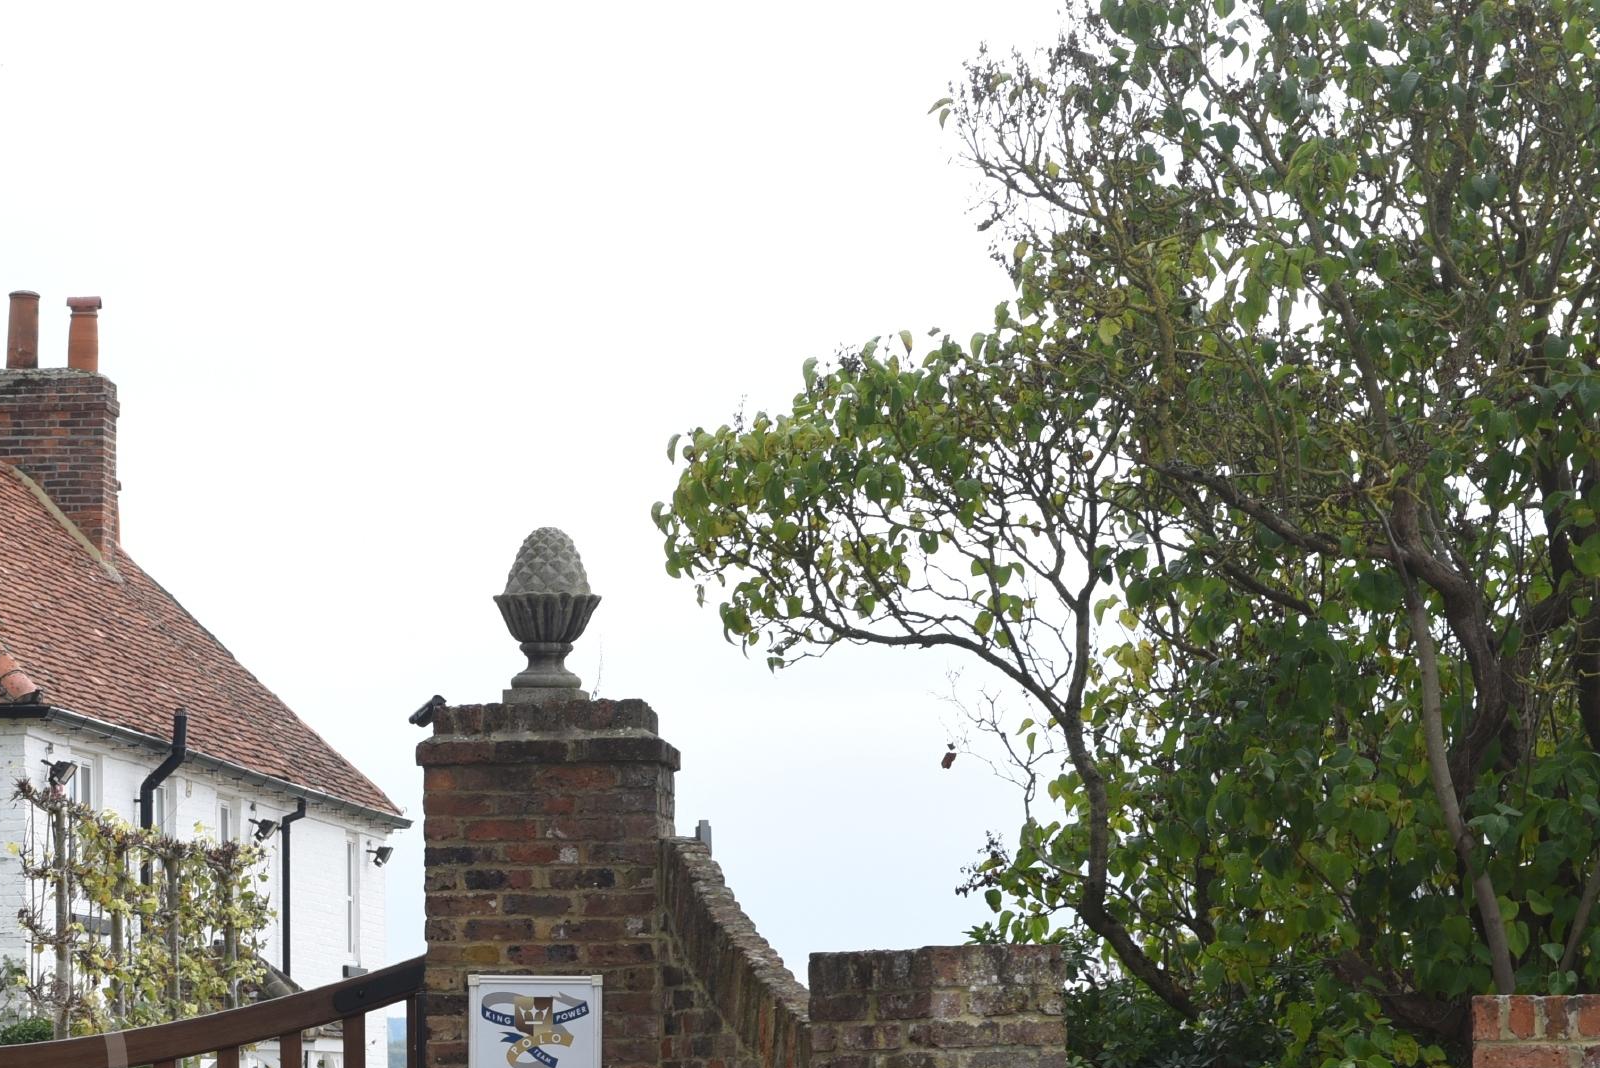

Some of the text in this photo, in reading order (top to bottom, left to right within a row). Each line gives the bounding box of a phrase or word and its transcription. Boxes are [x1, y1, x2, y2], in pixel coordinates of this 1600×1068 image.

[485, 1007, 588, 1025] KING POWER
[511, 1033, 561, 1055] POLO
[533, 1048, 552, 1064] TEAM
